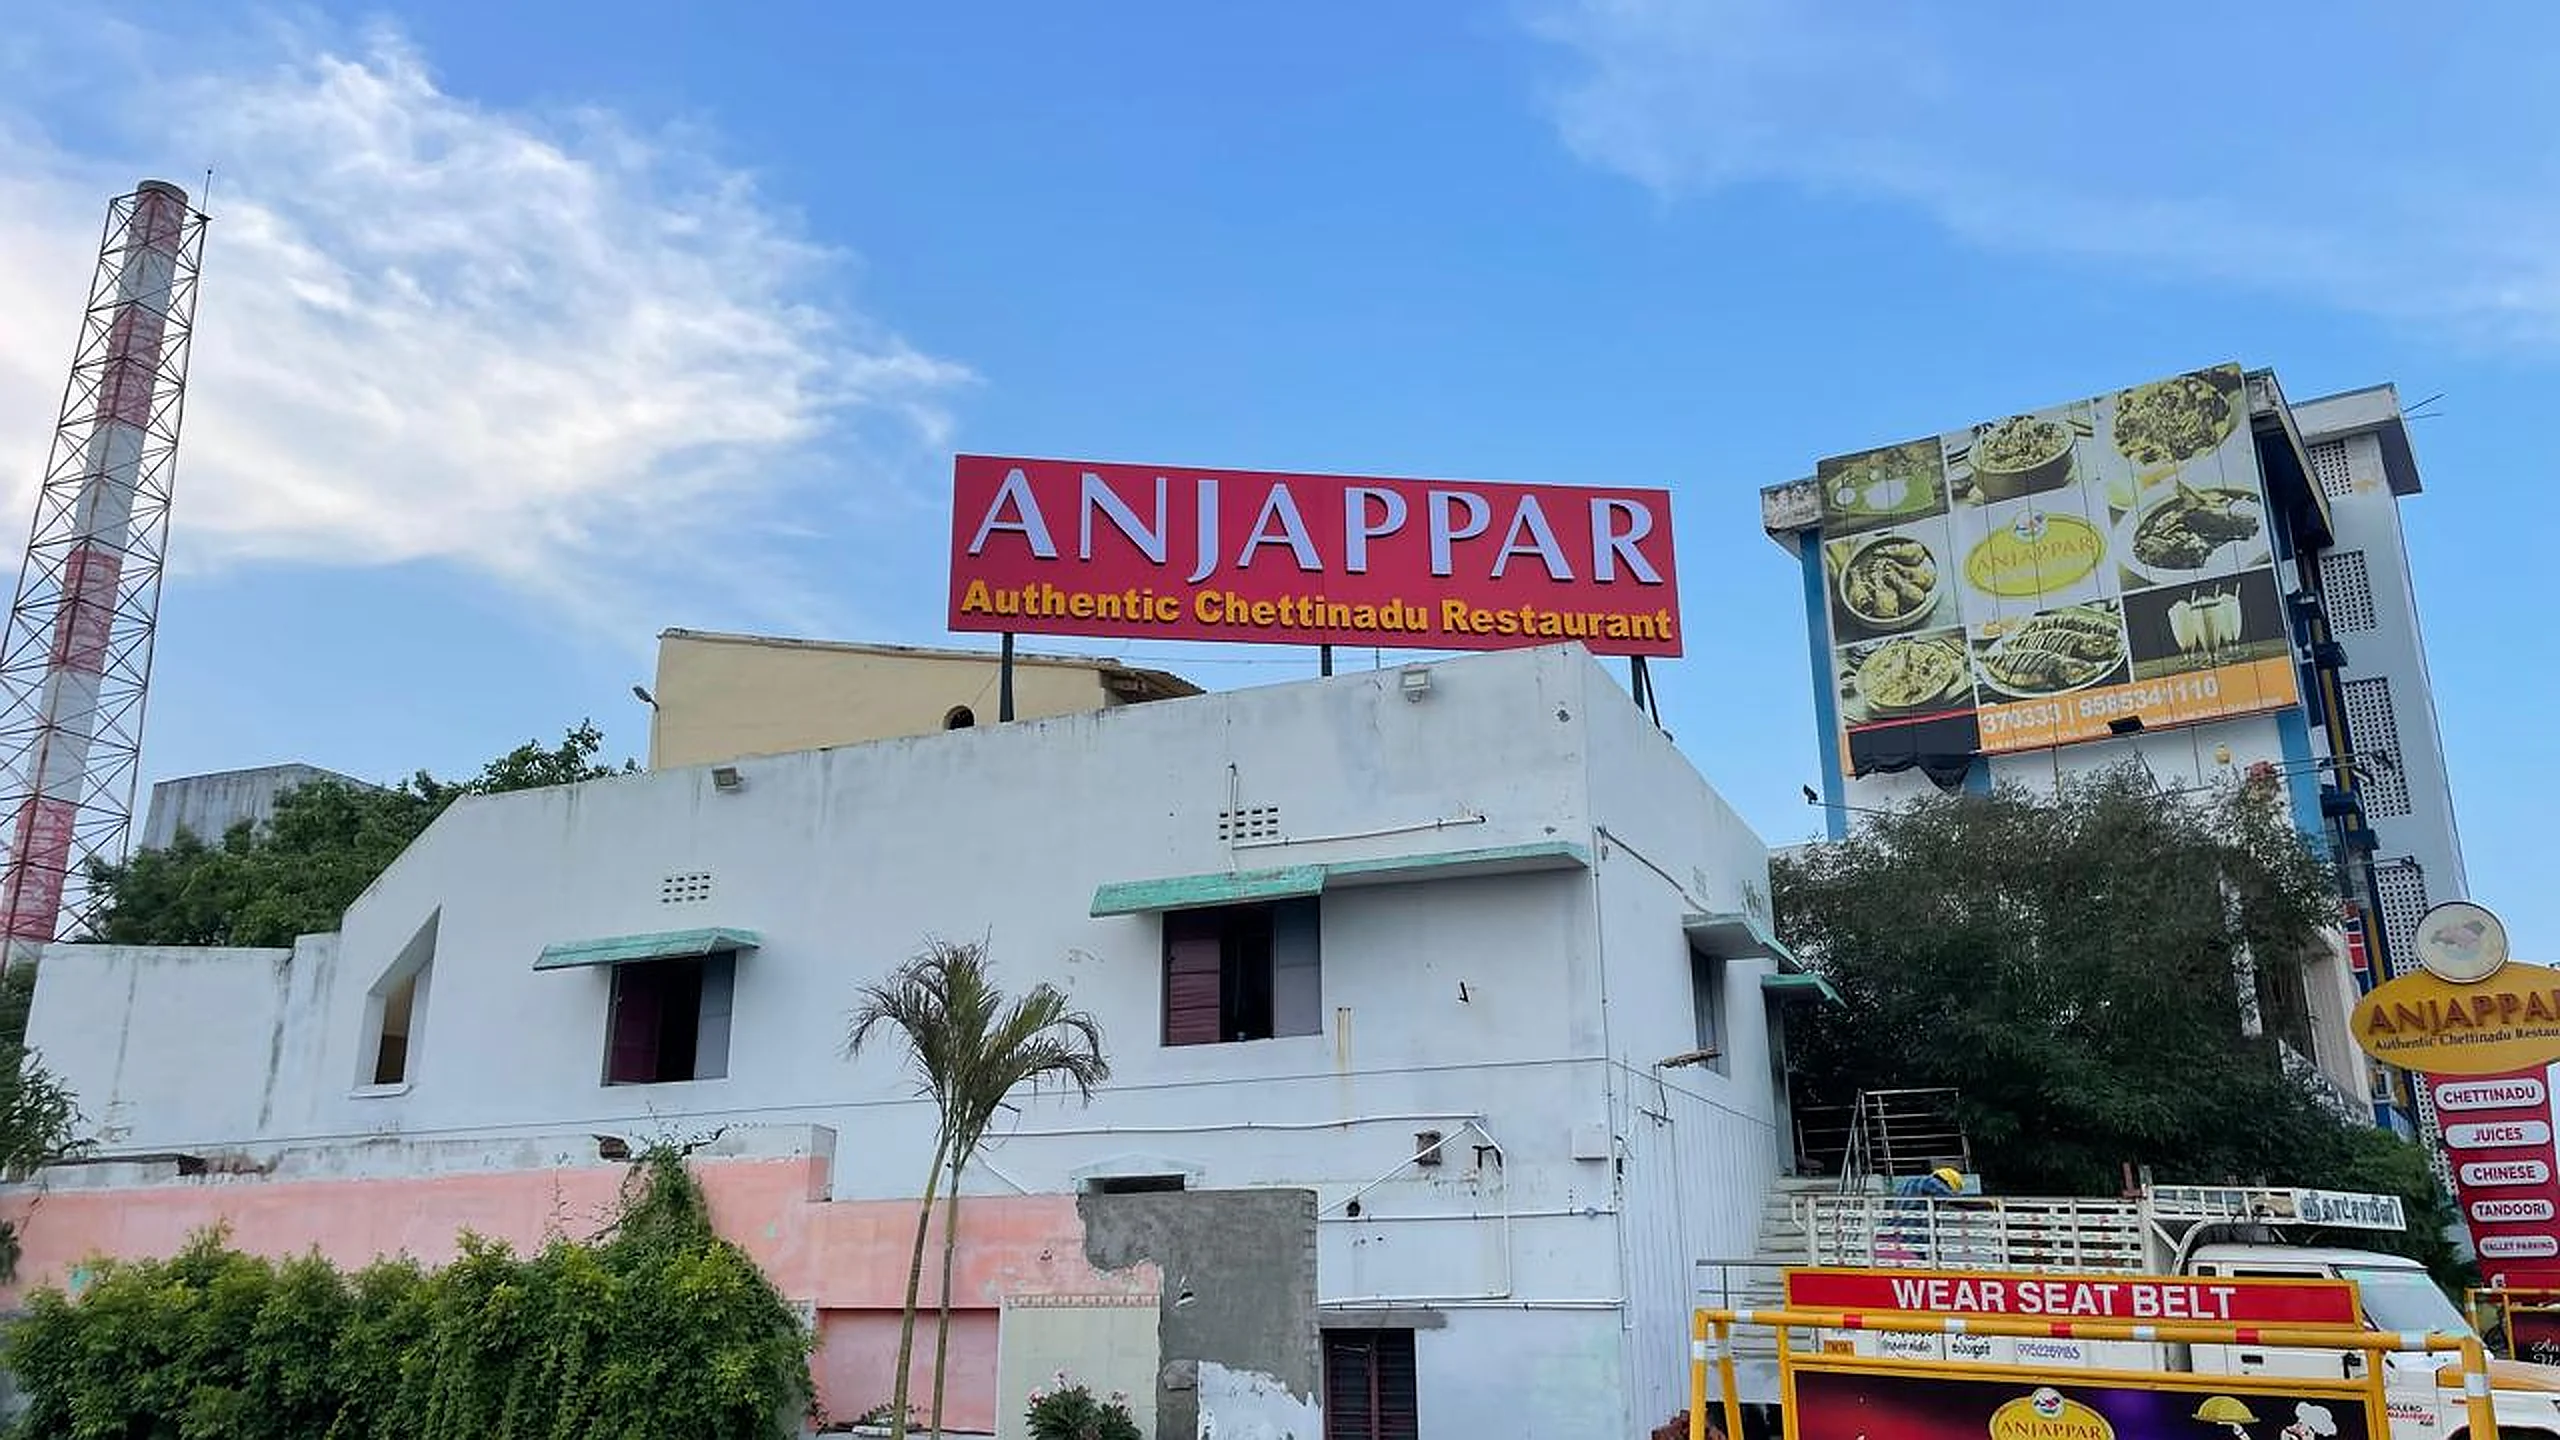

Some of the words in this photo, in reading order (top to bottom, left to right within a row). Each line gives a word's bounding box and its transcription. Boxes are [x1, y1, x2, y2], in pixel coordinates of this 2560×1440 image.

[967, 468, 1664, 584] ANJAPPAR
[1976, 535, 2097, 573] ANJAPPAR
[960, 579, 1182, 623] Authentic
[1194, 590, 1429, 632] Chettinadu
[1440, 598, 1673, 639] Restaurant
[2443, 1085, 2536, 1104] CHETTINADU
[2473, 1127, 2523, 1142] JUICES
[2473, 1165, 2536, 1180] CHINESE
[2476, 1203, 2548, 1217] TANDOORI
[1891, 1279, 2006, 1312] WEAR
[2016, 1282, 2118, 1316] SEAT
[2131, 1285, 2236, 1320] BELT
[2001, 1420, 2101, 1440] ANJAPPAR
